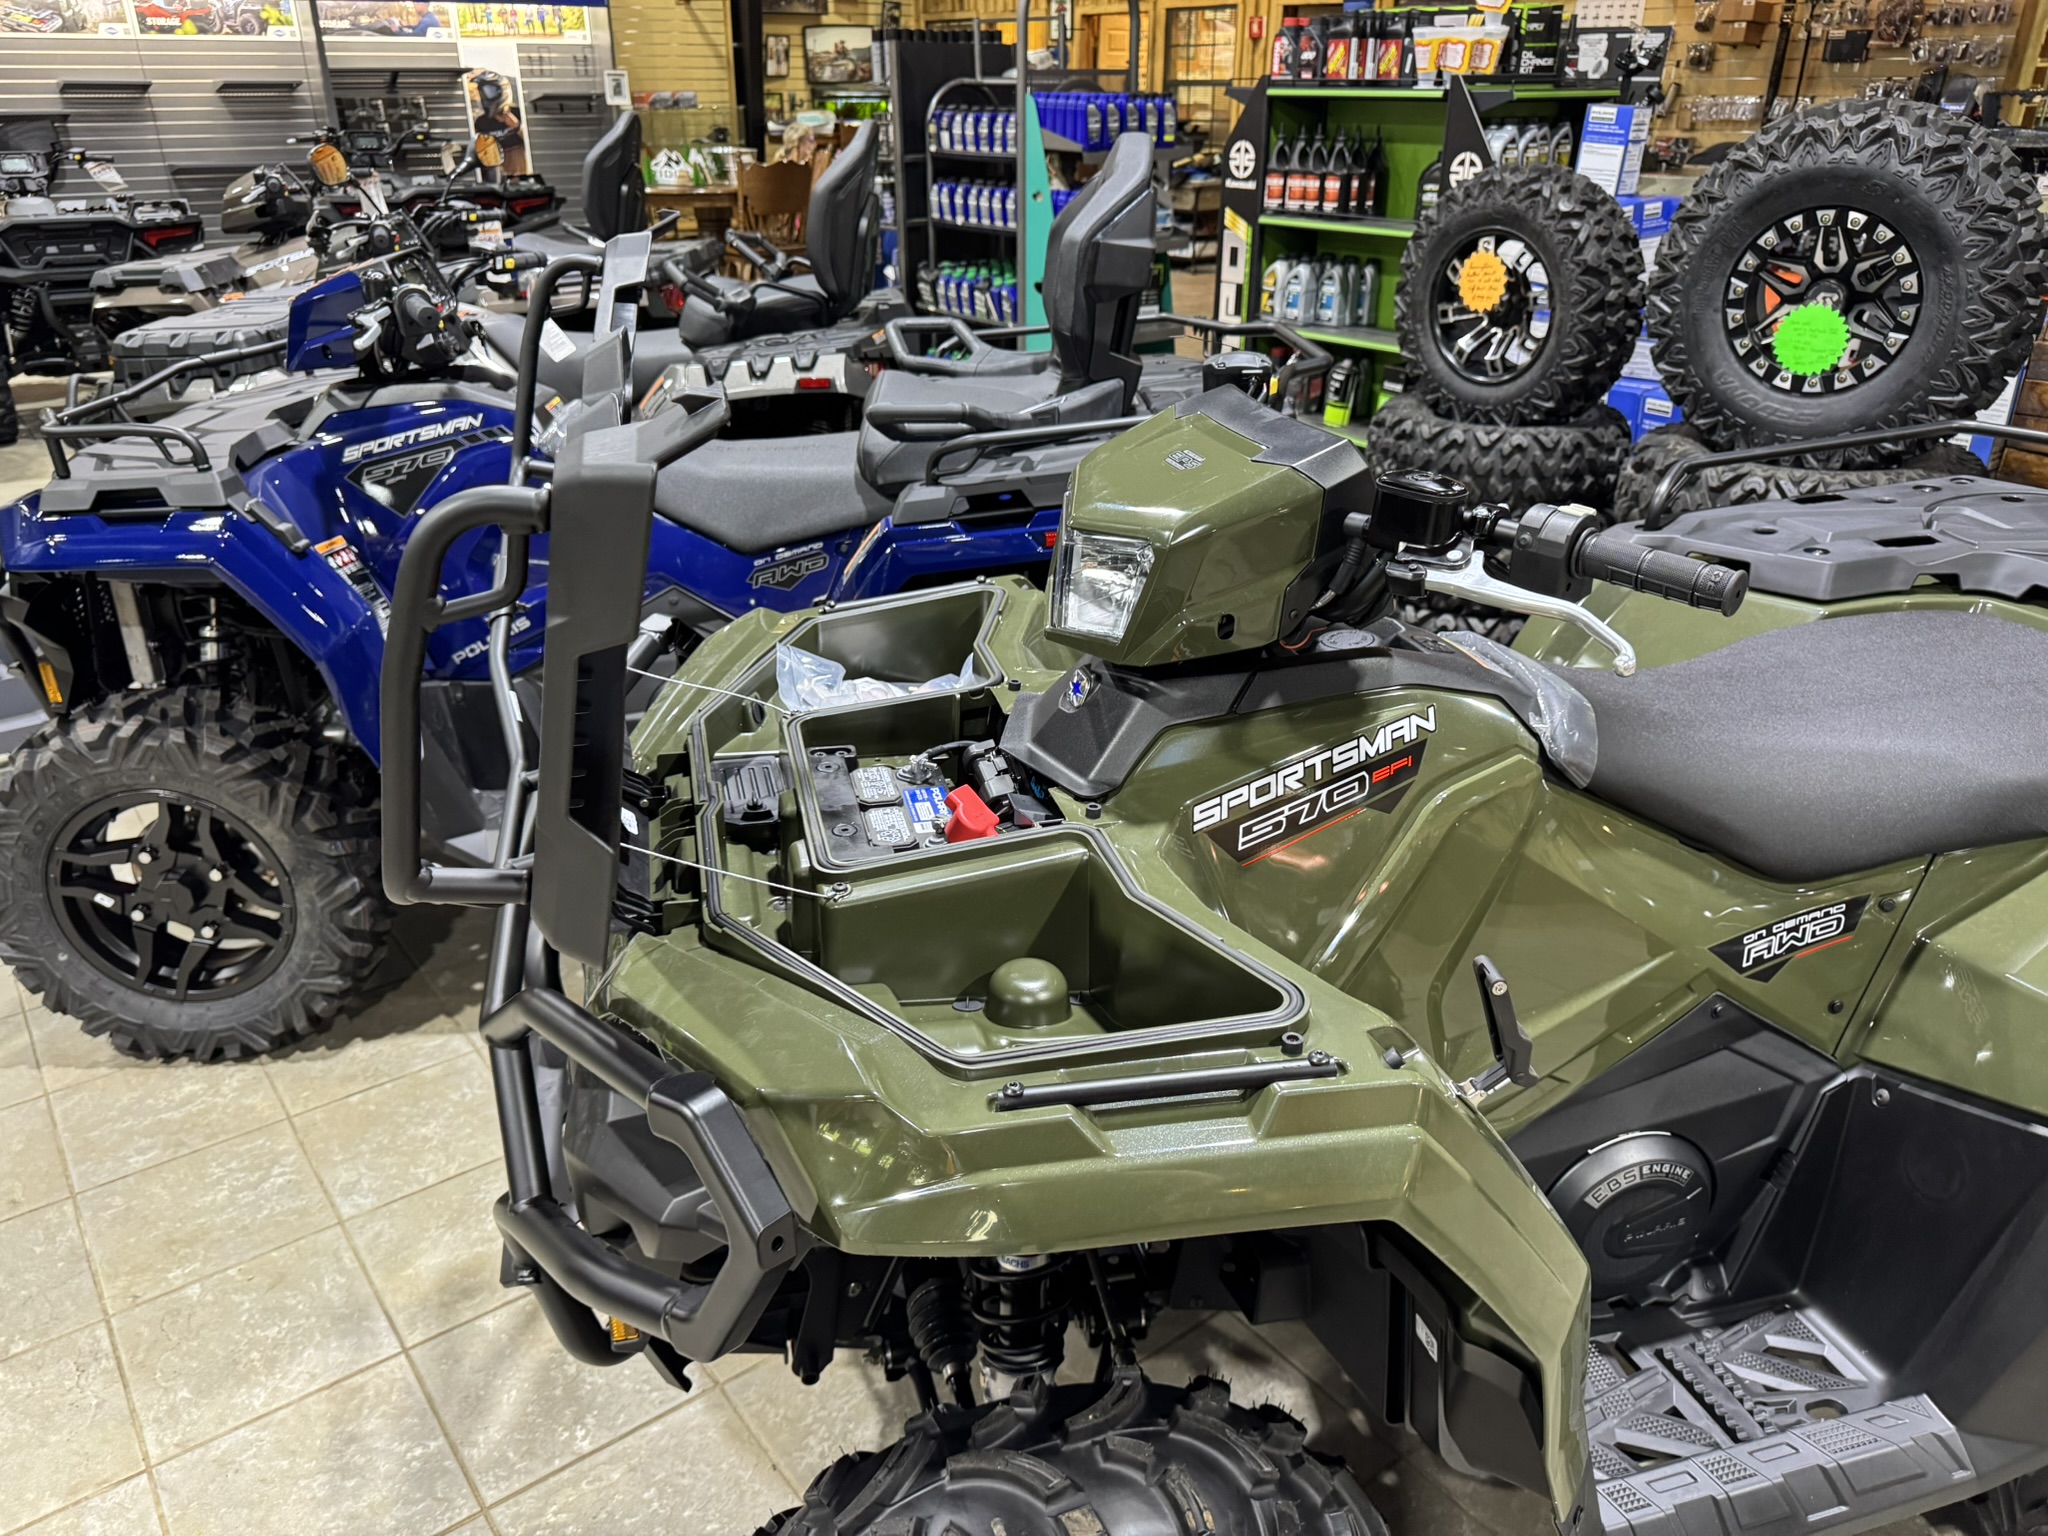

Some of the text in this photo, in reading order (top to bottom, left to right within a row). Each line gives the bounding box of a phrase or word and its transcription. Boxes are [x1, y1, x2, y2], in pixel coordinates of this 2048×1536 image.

[145, 17, 182, 26] STORAGE
[1519, 66, 1535, 74] KIT
[1520, 58, 1555, 66] CHANGE
[342, 413, 484, 463] SPORTSMAN
[361, 446, 455, 483] 570
[752, 554, 829, 590] AWD
[1192, 703, 1437, 834] SPORTSMAN
[1238, 755, 1413, 851] 570 EFI
[1742, 913, 1846, 968] AWD
[1743, 903, 1846, 945] ON DEMAND
[1591, 1163, 1691, 1204] EBS ENGINE
